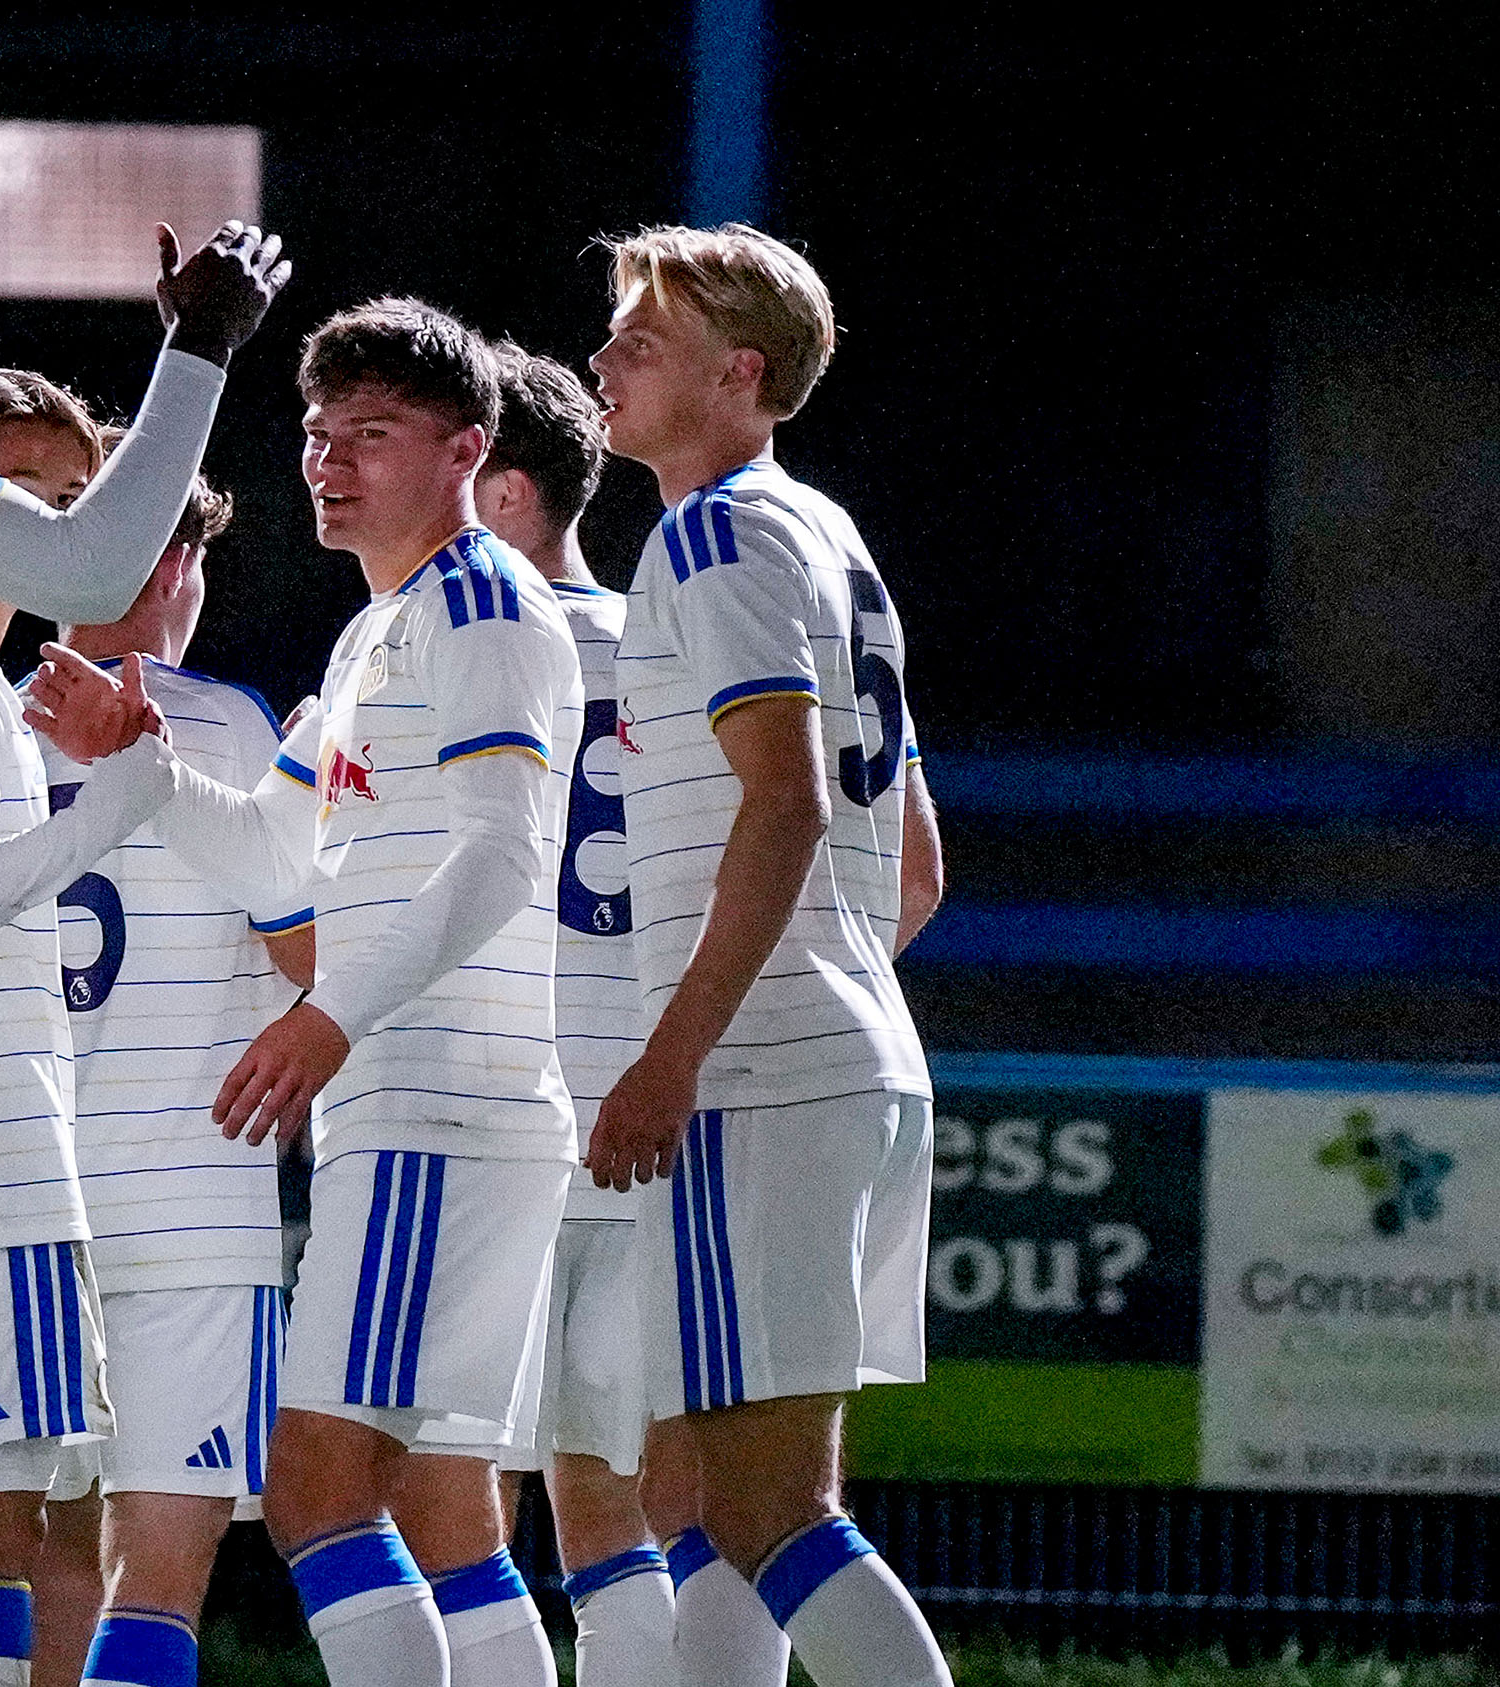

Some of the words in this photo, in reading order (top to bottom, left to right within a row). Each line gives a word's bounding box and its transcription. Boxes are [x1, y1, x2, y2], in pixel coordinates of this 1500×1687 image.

[838, 568, 904, 808] 5
[933, 1115, 1114, 1195] ess
[929, 1222, 1150, 1315] ou?
